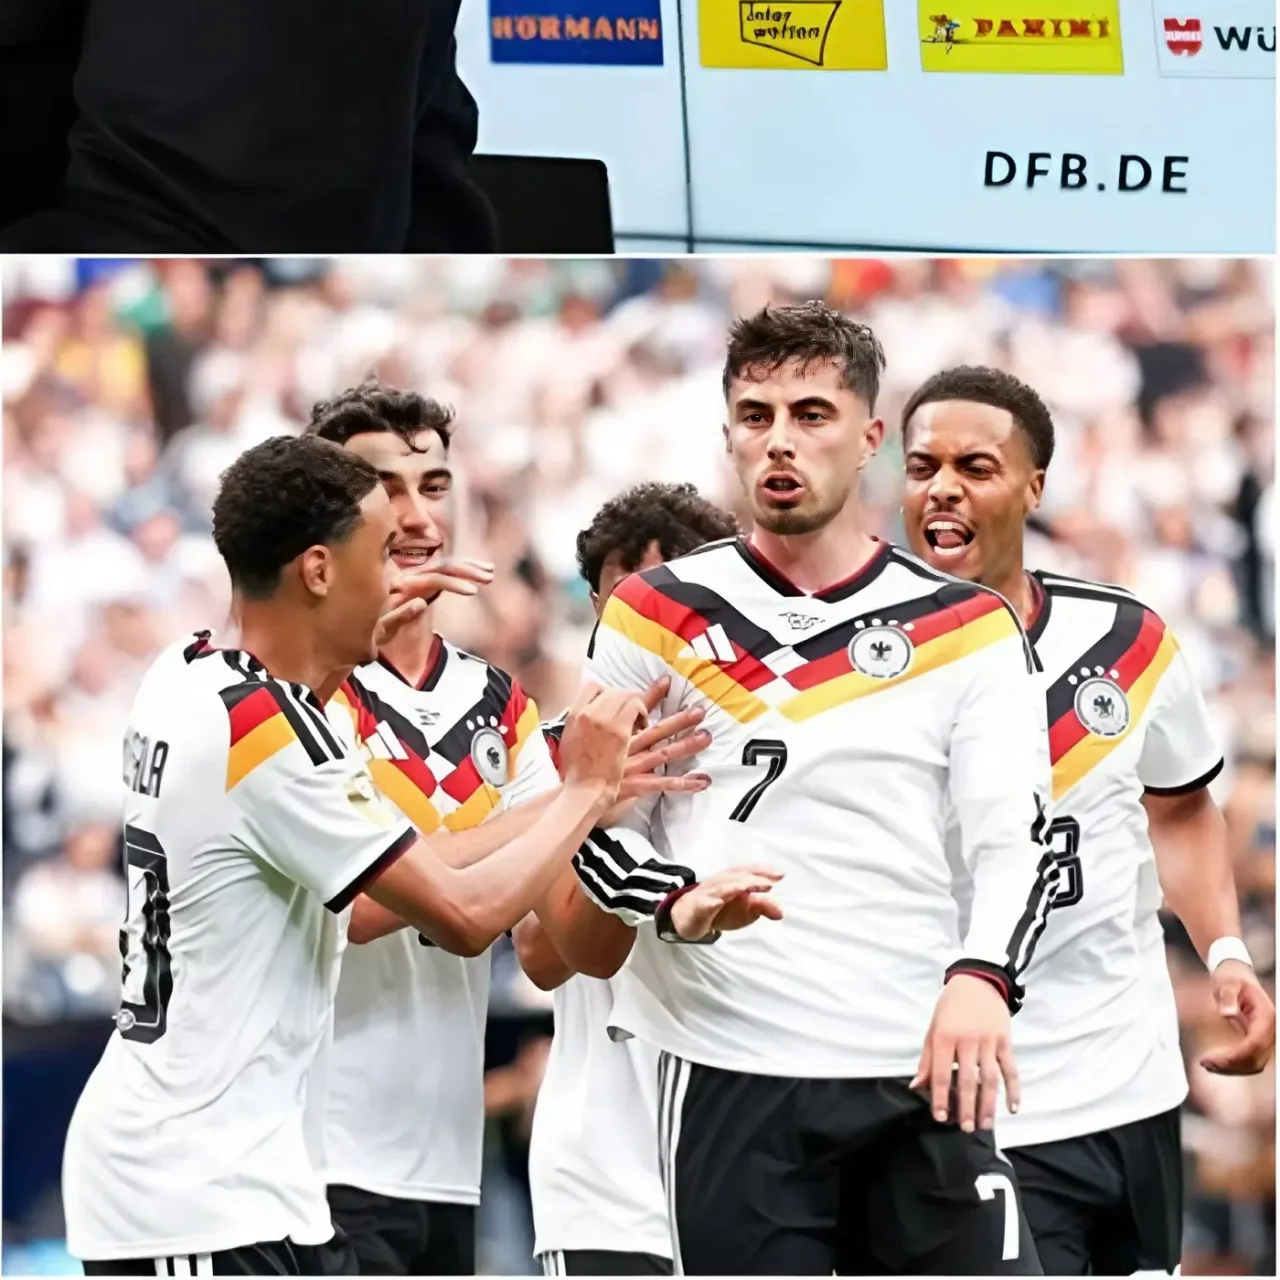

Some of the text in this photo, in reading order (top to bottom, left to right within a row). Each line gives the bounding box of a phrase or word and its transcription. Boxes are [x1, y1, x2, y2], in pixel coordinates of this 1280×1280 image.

[983, 150, 1190, 194] DFB.DE
[728, 738, 788, 823] 7
[974, 1172, 1020, 1262] 7
